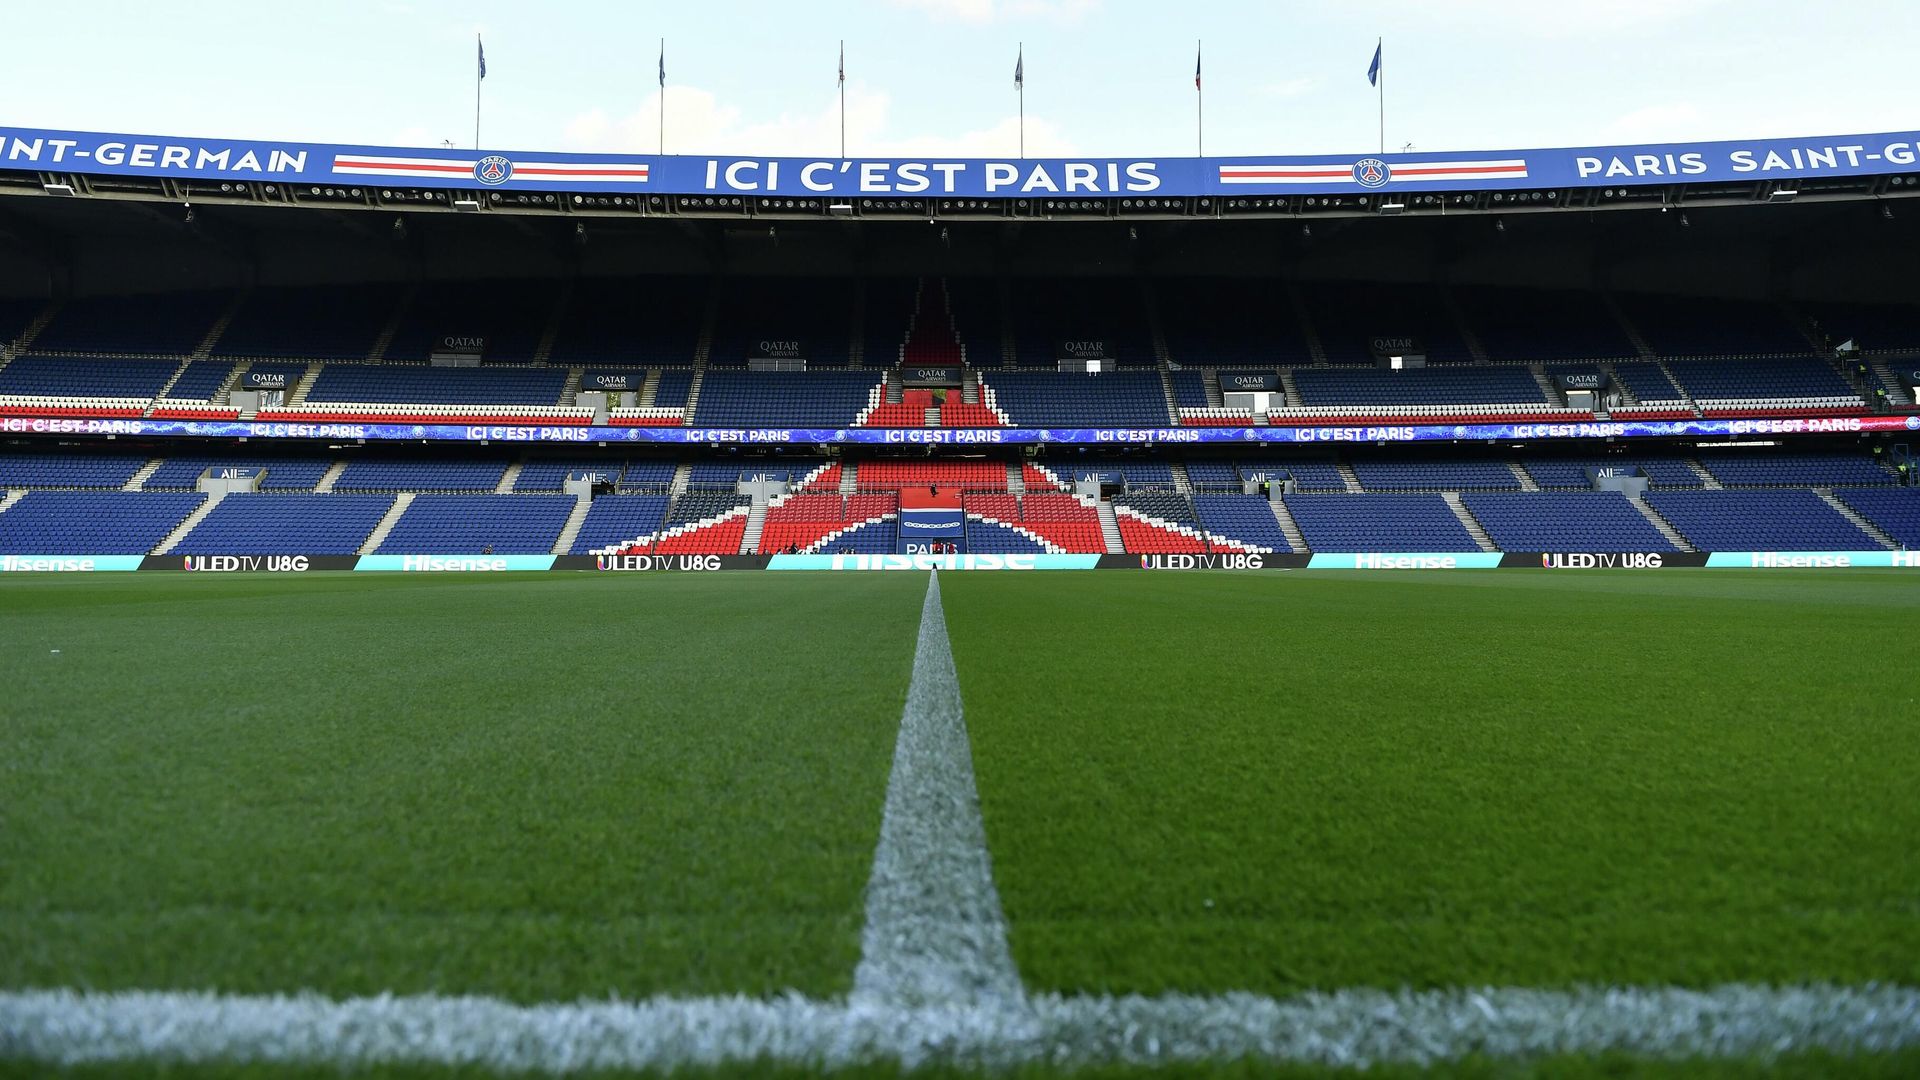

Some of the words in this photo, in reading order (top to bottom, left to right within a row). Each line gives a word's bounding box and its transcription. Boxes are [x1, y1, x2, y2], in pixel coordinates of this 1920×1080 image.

[481, 157, 508, 165] PARIS
[1576, 152, 1708, 178] PARIS
[1729, 142, 1920, 172] SAINT-G
[706, 160, 779, 191] ICI
[800, 161, 967, 193] C'EST
[985, 162, 1161, 192] PARIS
[444, 336, 483, 348] QATAR
[760, 341, 799, 352] QATAR
[1065, 341, 1104, 352] QATAR
[252, 373, 285, 384] QATAR
[596, 375, 626, 385] QATAR
[918, 369, 946, 378] QATAR
[1566, 375, 1598, 385] QATAR
[1234, 376, 1264, 386] QATAR
[3, 418, 27, 431] ICI
[32, 418, 84, 433] C'EST
[88, 420, 142, 434] PARIS
[250, 424, 270, 436] ICI
[274, 424, 317, 437] C'EST
[320, 425, 364, 438] PARIS
[1514, 425, 1533, 437] ICI
[1535, 424, 1577, 437] C'EST
[1580, 423, 1624, 436] PARIS
[1729, 420, 1752, 433] ICI
[1756, 419, 1805, 433] C'EST
[1808, 418, 1861, 432] PARIS
[466, 427, 487, 440] ICI
[491, 427, 537, 440] C'EST
[541, 427, 588, 441] PARIS
[686, 430, 704, 441] ICI
[707, 430, 746, 441] C'EST
[749, 430, 790, 441] PARIS
[885, 430, 904, 442] ICI
[909, 430, 952, 442] C'EST
[955, 430, 1001, 442] PARIS
[1096, 430, 1113, 441] ICI
[1117, 430, 1156, 441] C'EST
[1158, 430, 1199, 441] PARIS
[1295, 428, 1315, 441] ICI
[1319, 428, 1363, 441] C'EST
[1367, 427, 1414, 441] PARIS
[906, 543, 959, 554] PAI
[267, 555, 309, 571] U8G
[402, 555, 507, 571] Hisense
[680, 555, 722, 571] U8G
[1222, 554, 1264, 569] U8G
[1355, 553, 1456, 569] Hisense
[1622, 553, 1663, 568] U8G
[1751, 552, 1850, 568] Hisense
